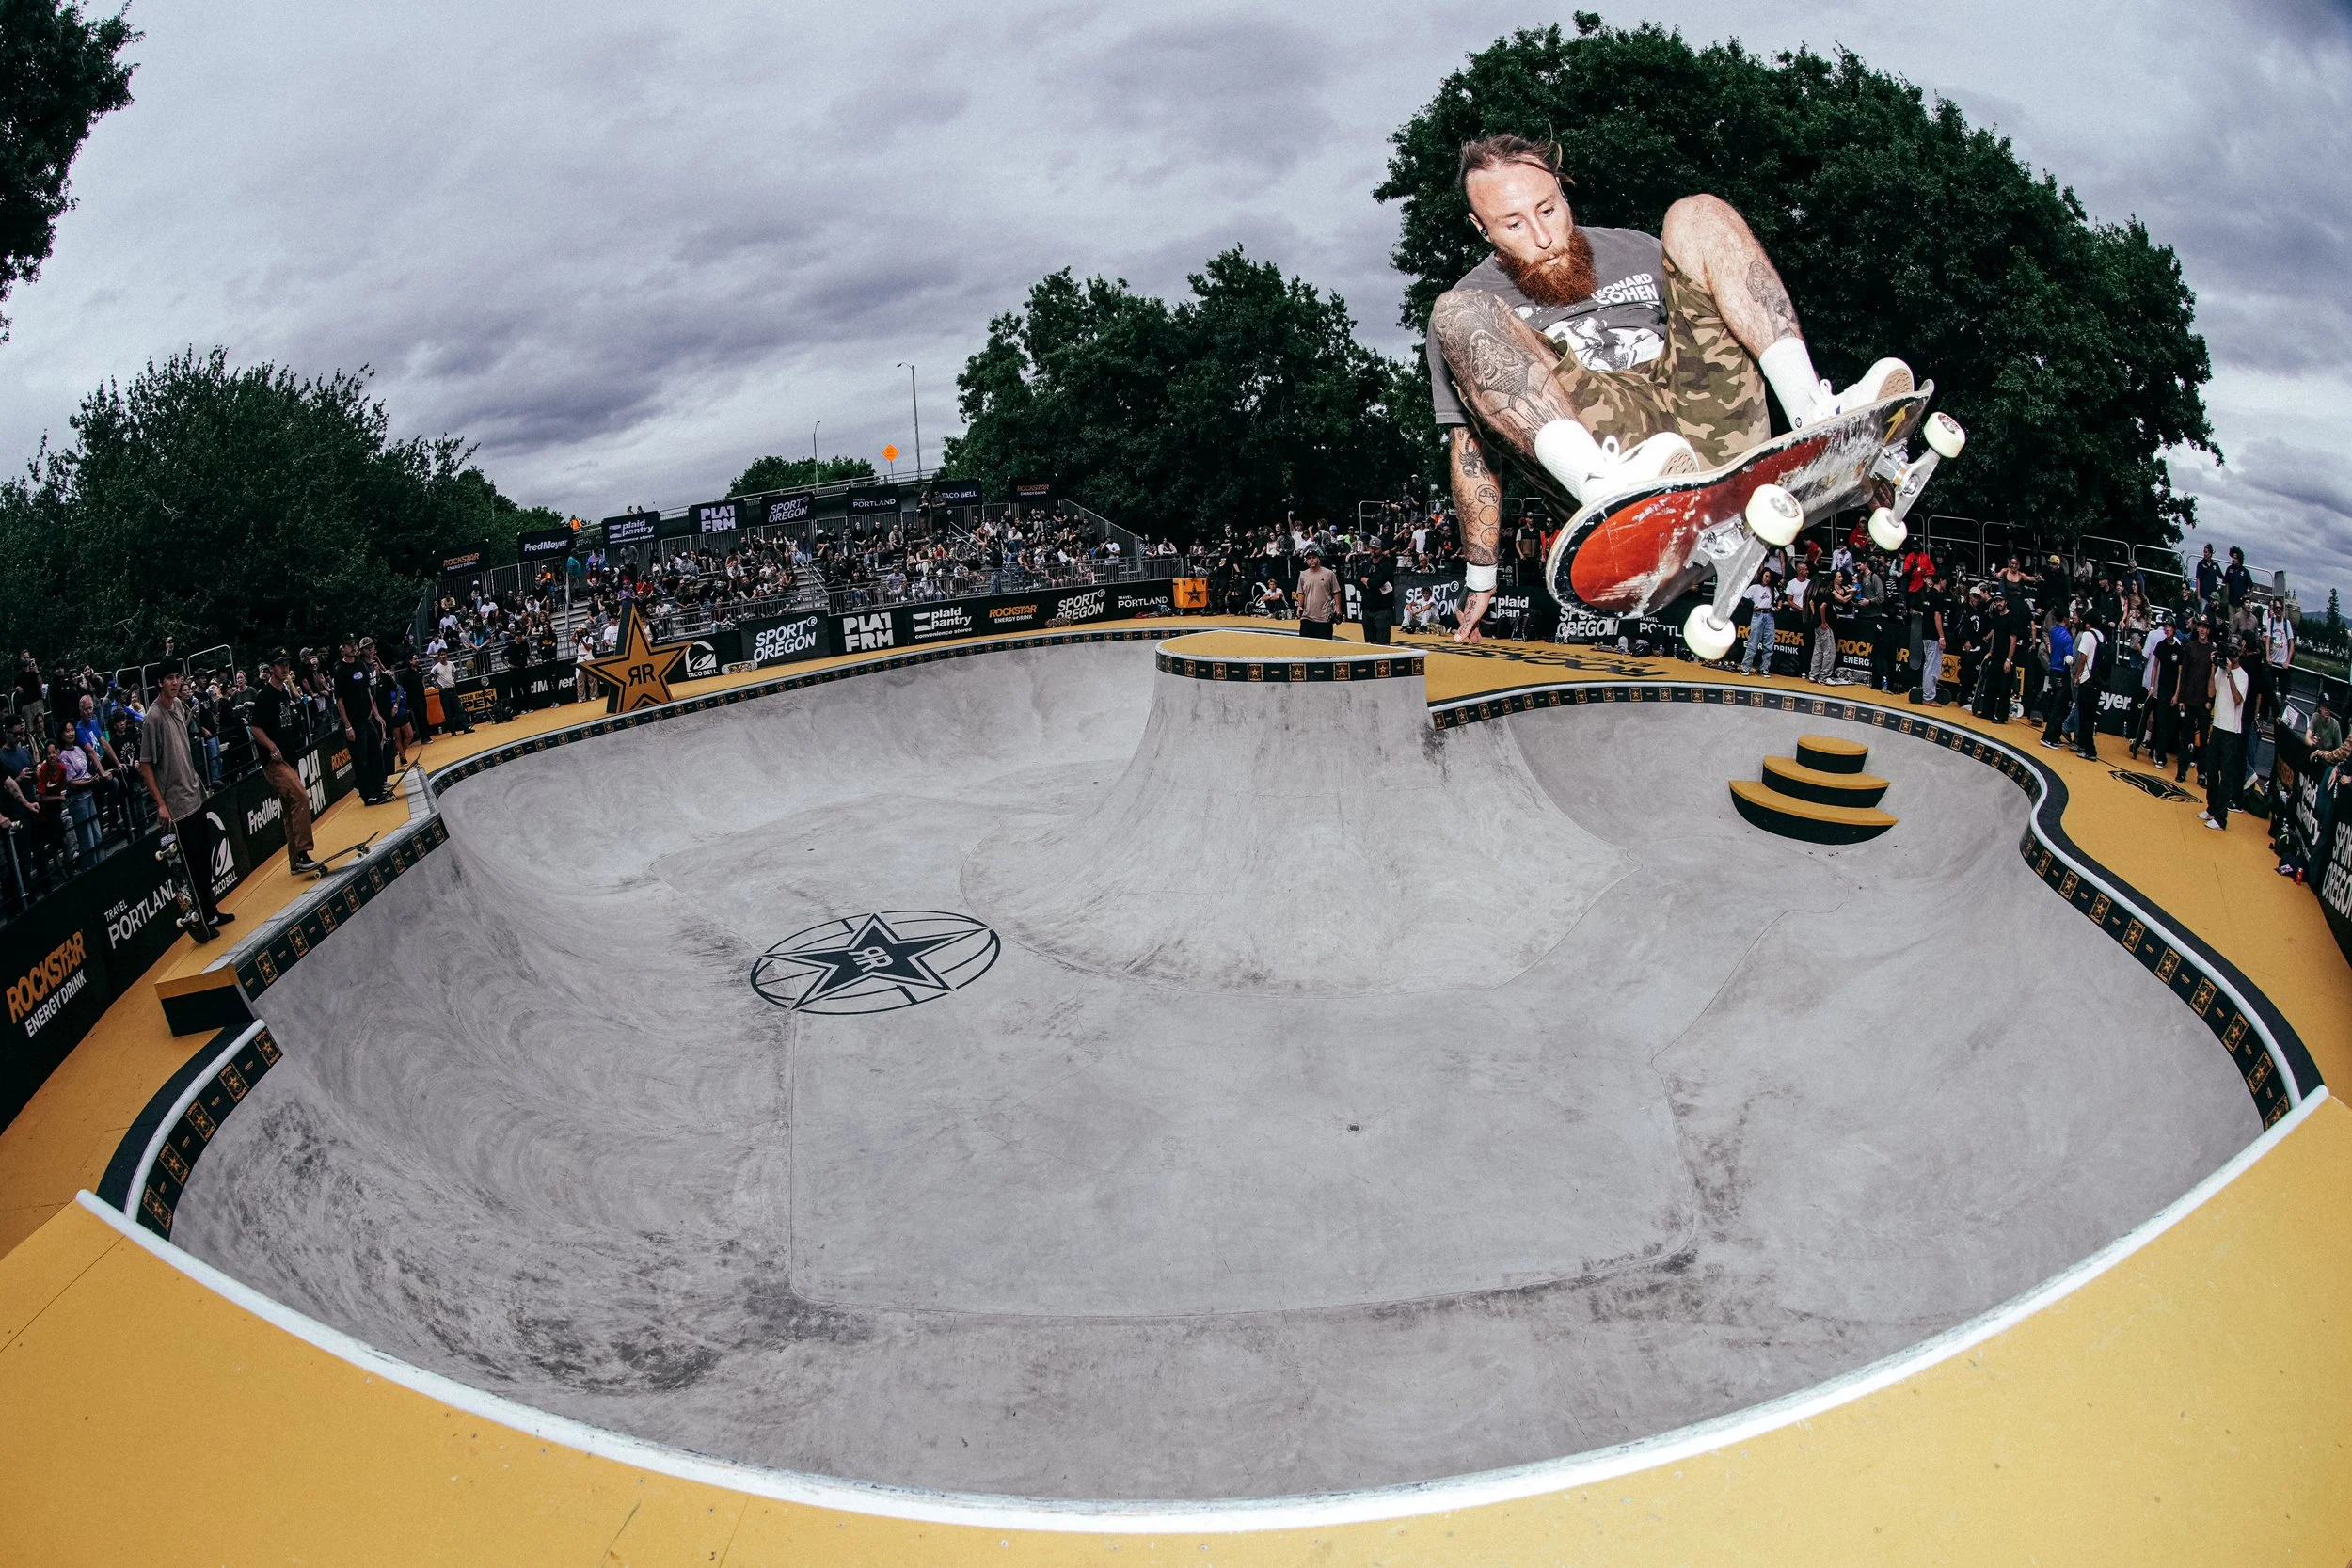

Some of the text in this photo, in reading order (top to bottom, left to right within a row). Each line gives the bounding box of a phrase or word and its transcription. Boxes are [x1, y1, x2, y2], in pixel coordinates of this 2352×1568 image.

[1590, 273, 1653, 299] LEONARD
[1596, 284, 1659, 305] COHEN
[1017, 483, 1049, 492] ROCKSTAR
[853, 499, 896, 508] PORTLAND
[768, 506, 807, 523] OREGON
[623, 519, 645, 531] plaid
[623, 525, 654, 537] pantry
[701, 517, 736, 532] FRM
[443, 553, 480, 566] ROCKSTAR
[1118, 596, 1168, 608] PORTLAND
[1498, 595, 1529, 608] plaid
[931, 607, 961, 620] plaid
[990, 604, 1037, 618] ROCKSTAR
[1498, 608, 1520, 618] pan
[931, 615, 971, 629] pantry
[845, 630, 894, 651] FRM
[915, 630, 952, 640] convenience
[1737, 625, 1804, 646] ROSTAR
[754, 632, 817, 662] OREGON
[1843, 656, 1872, 667] ENERG
[462, 696, 495, 709] PEN
[247, 798, 282, 835] FredMey
[212, 871, 238, 897] TACO BELL
[103, 899, 128, 922] TRAVEL
[6, 931, 87, 1024] ROCKSTAR
[24, 969, 87, 1038] ENERGY DRINK
